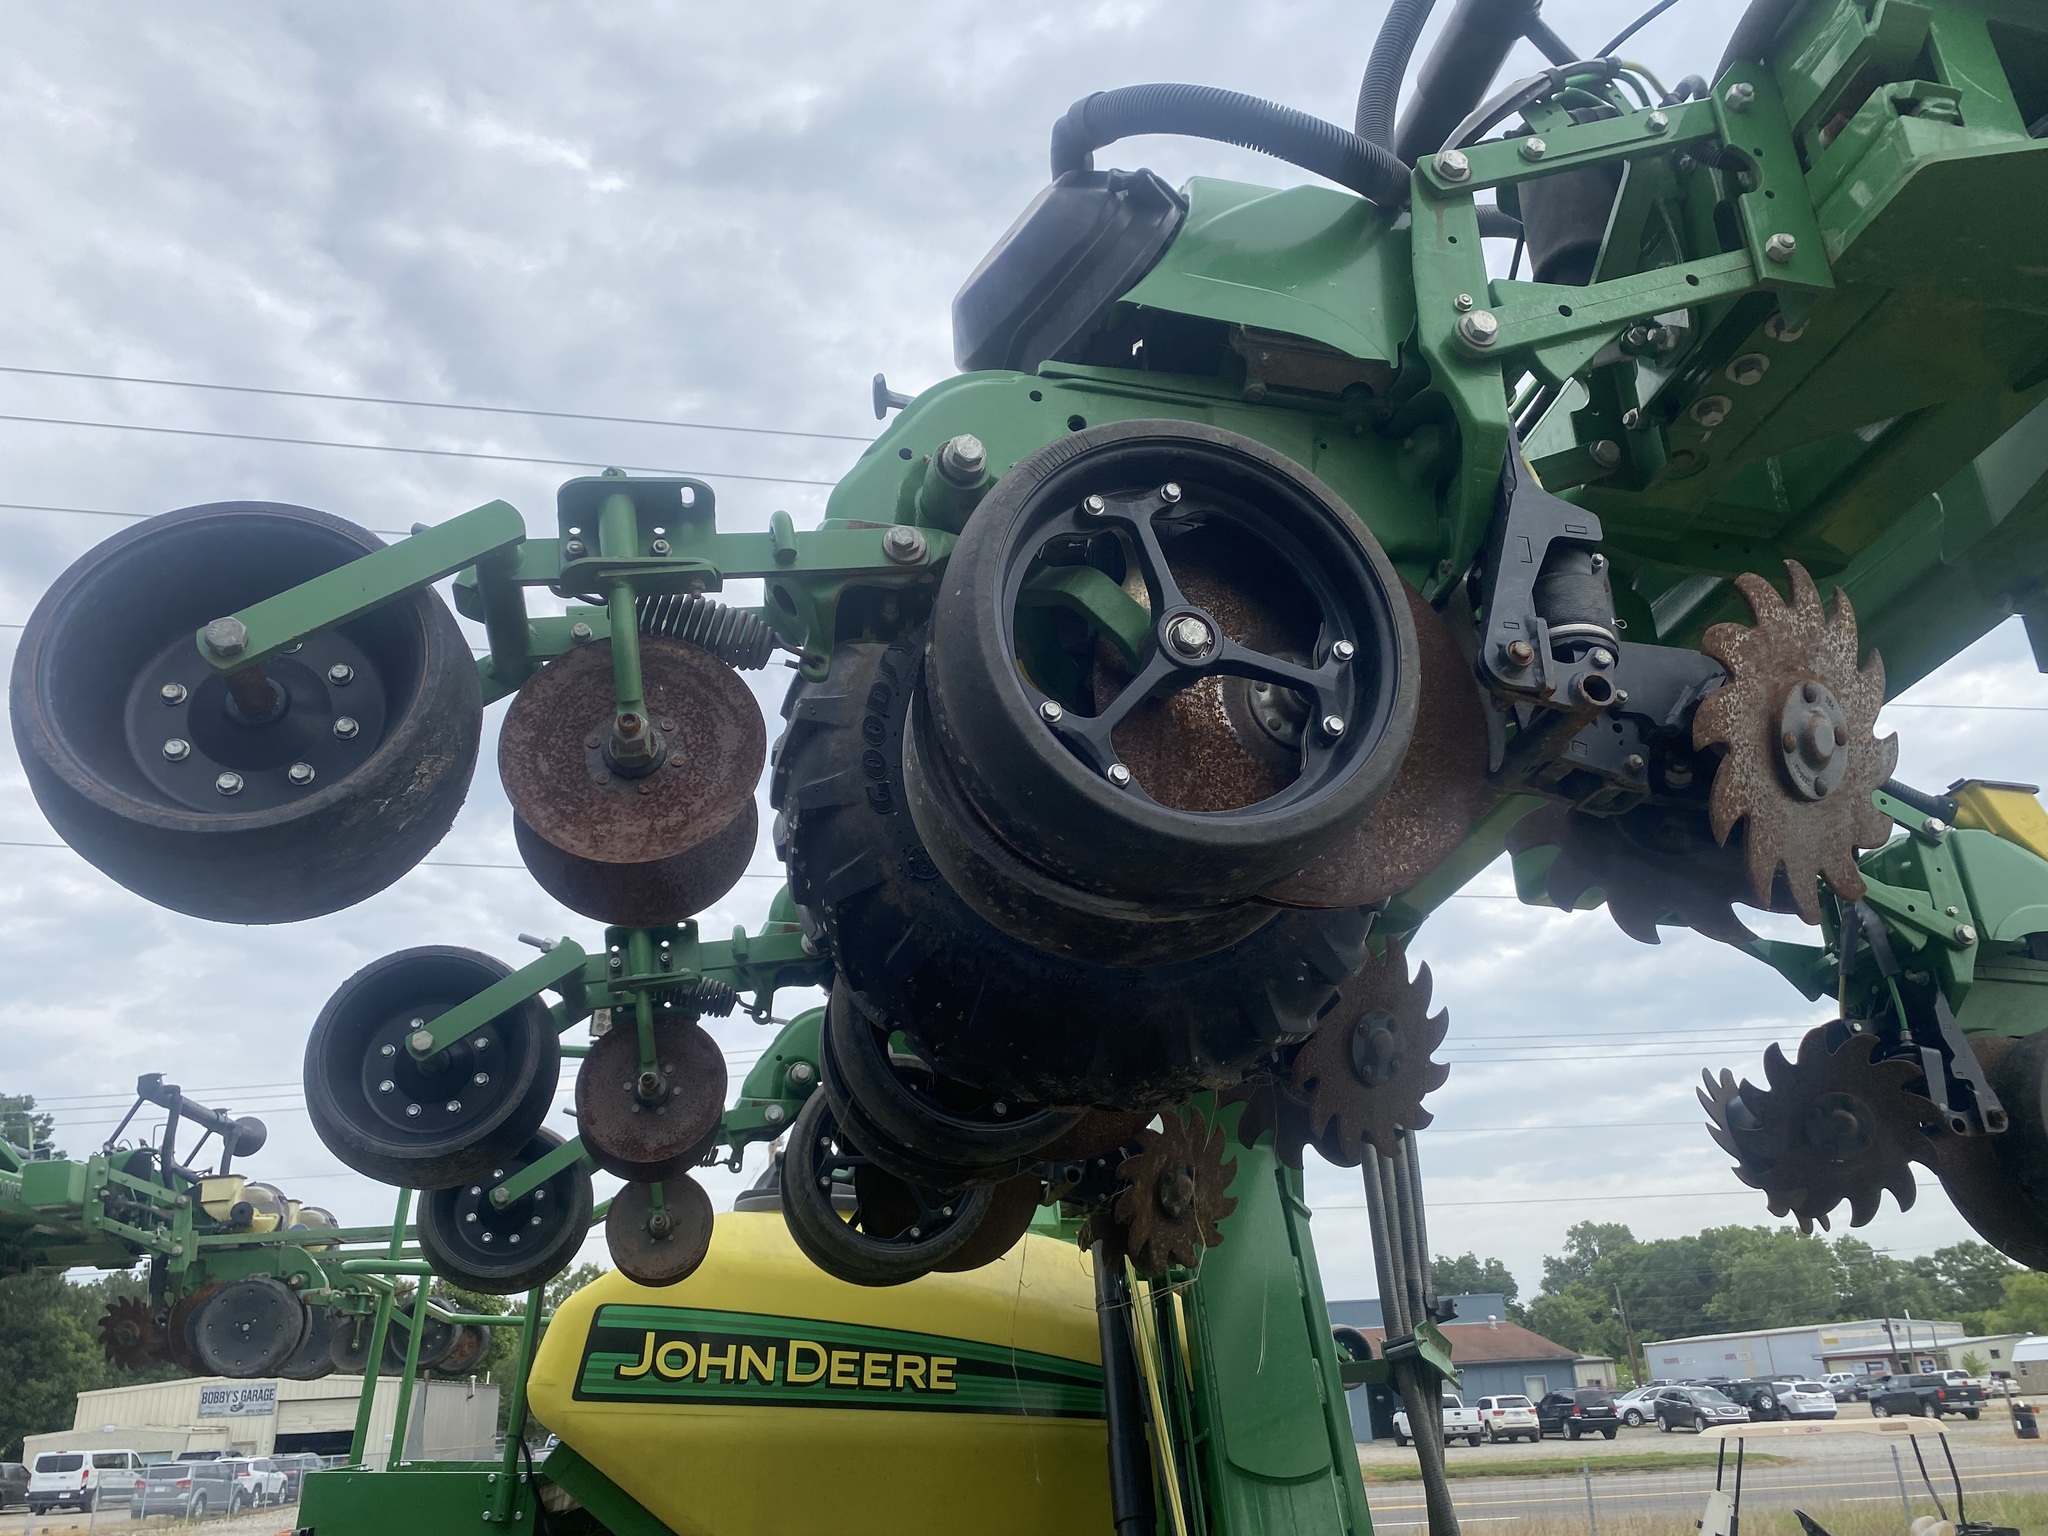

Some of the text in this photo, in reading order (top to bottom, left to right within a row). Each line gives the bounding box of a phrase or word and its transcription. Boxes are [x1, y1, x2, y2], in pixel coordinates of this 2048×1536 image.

[617, 1331, 958, 1391] JOHN DEERE
[201, 1388, 275, 1404] BOBBY'S GARAGE
